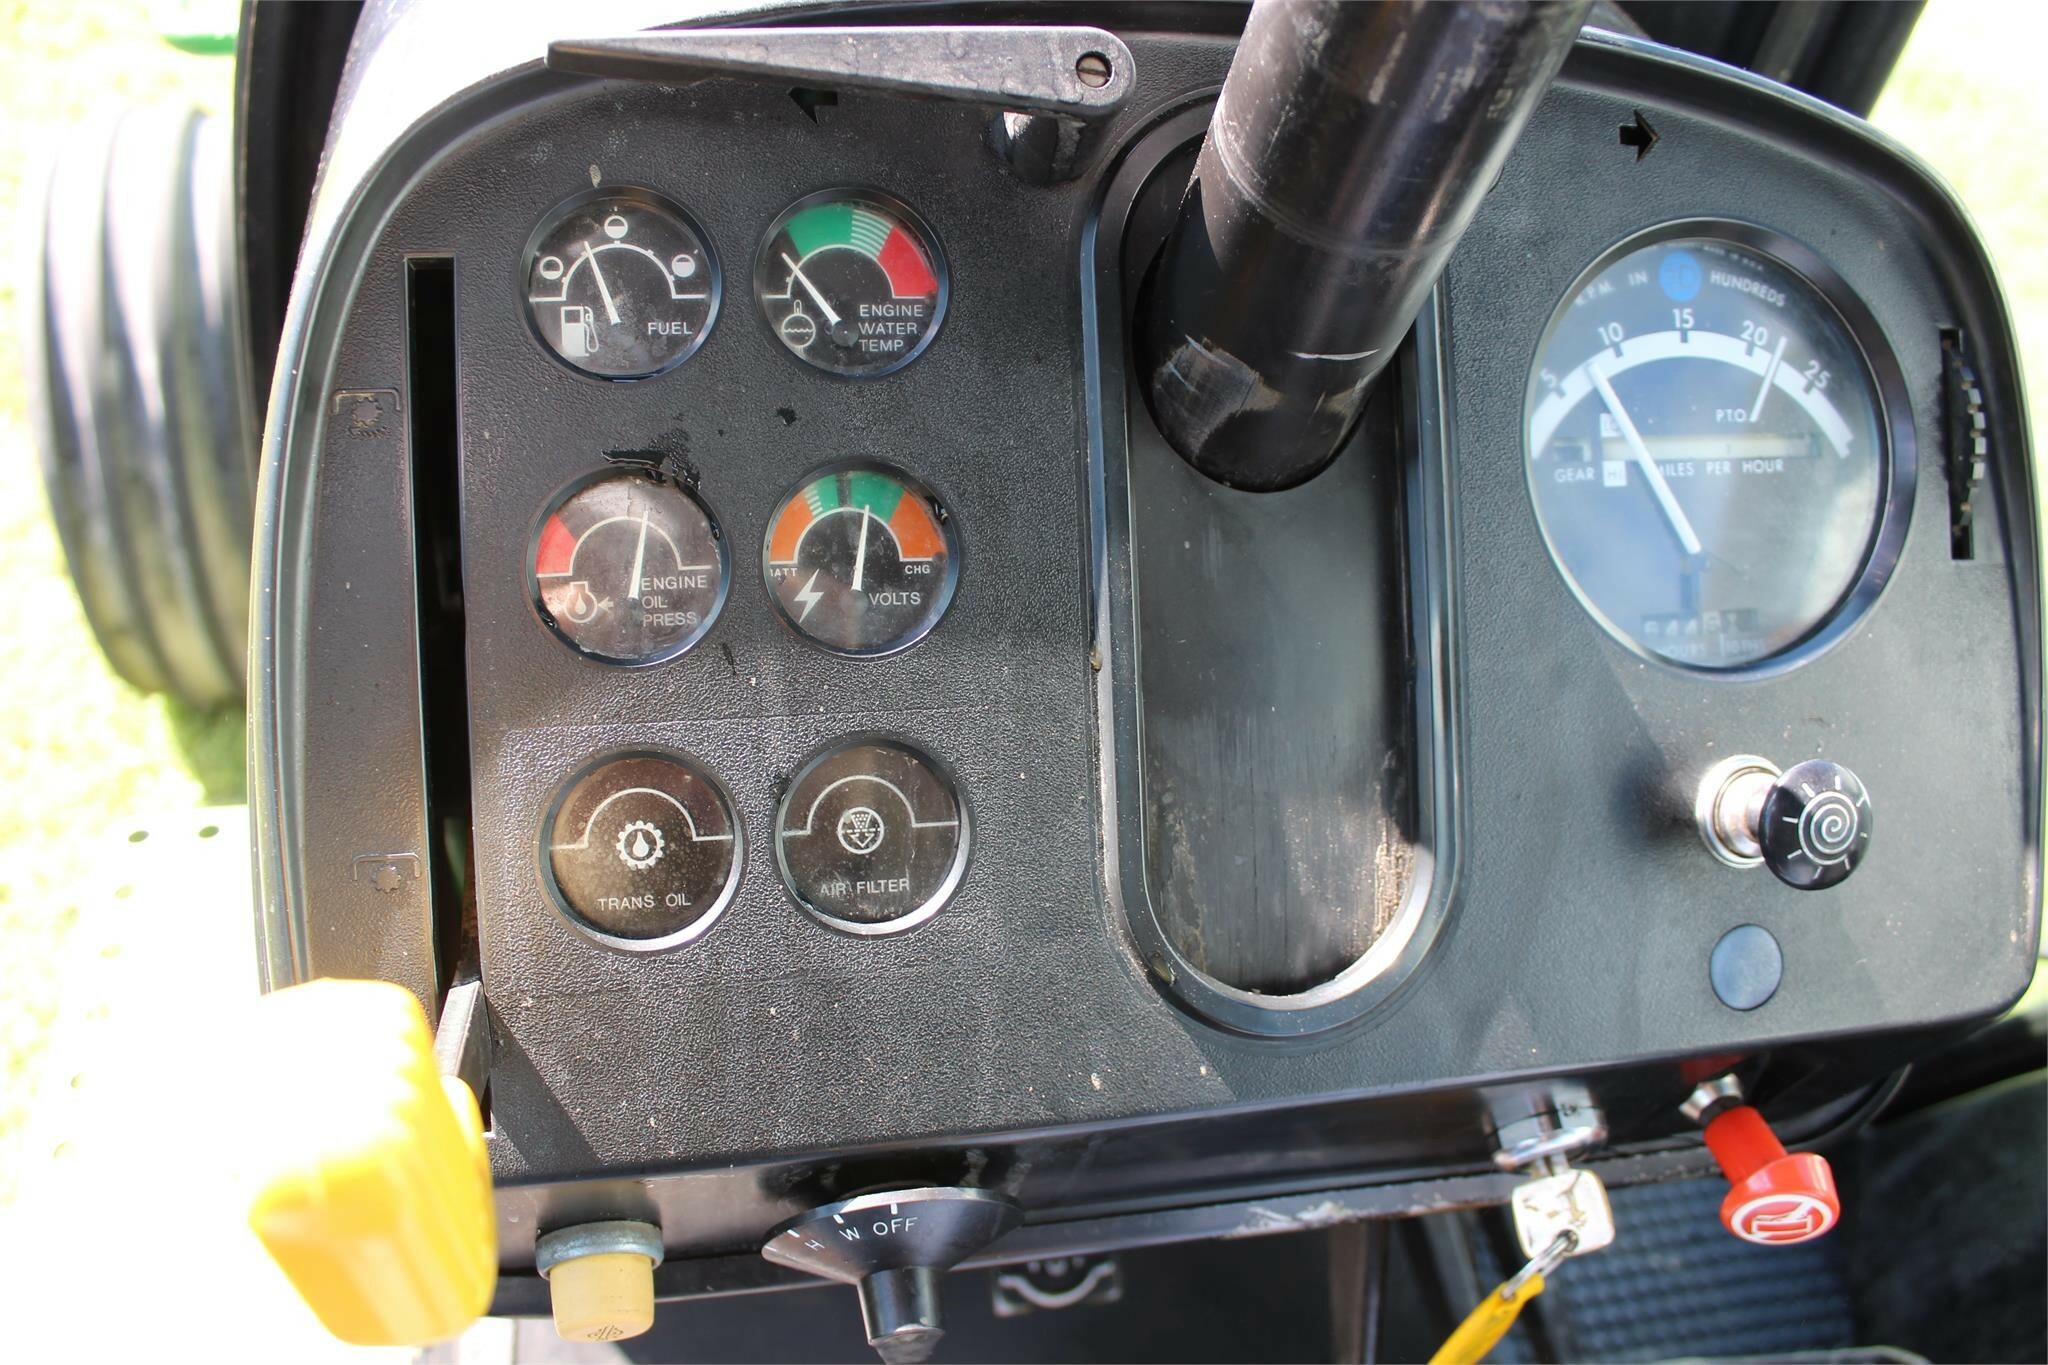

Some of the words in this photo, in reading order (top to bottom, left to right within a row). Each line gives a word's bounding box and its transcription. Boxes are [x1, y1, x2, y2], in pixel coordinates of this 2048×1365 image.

[1627, 270, 1648, 286] IN
[1710, 270, 1786, 308] HUNDREDS
[860, 304, 924, 318] ENGINE
[1672, 308, 1694, 328] 15
[648, 322, 693, 335] FUEL
[858, 322, 918, 335] WATER
[1598, 322, 1624, 346] 10
[1740, 320, 1768, 346] 20
[859, 339, 904, 352] TEMP
[1804, 360, 1831, 390] 25
[1555, 467, 1595, 483] GEAR
[1706, 461, 1731, 475] PER
[1742, 459, 1785, 474] HOUR
[904, 564, 931, 574] CHG
[641, 575, 707, 591] ENGINE
[641, 595, 666, 609] OIL
[868, 592, 921, 606] VOLTS
[643, 612, 697, 628] PRESS
[820, 882, 848, 898] AIR
[857, 878, 911, 896] FILTER
[598, 895, 655, 911] TRANS
[665, 893, 692, 908] OIL
[839, 1226, 861, 1241] W
[872, 1217, 918, 1236] OFF
[804, 1239, 825, 1251] H
